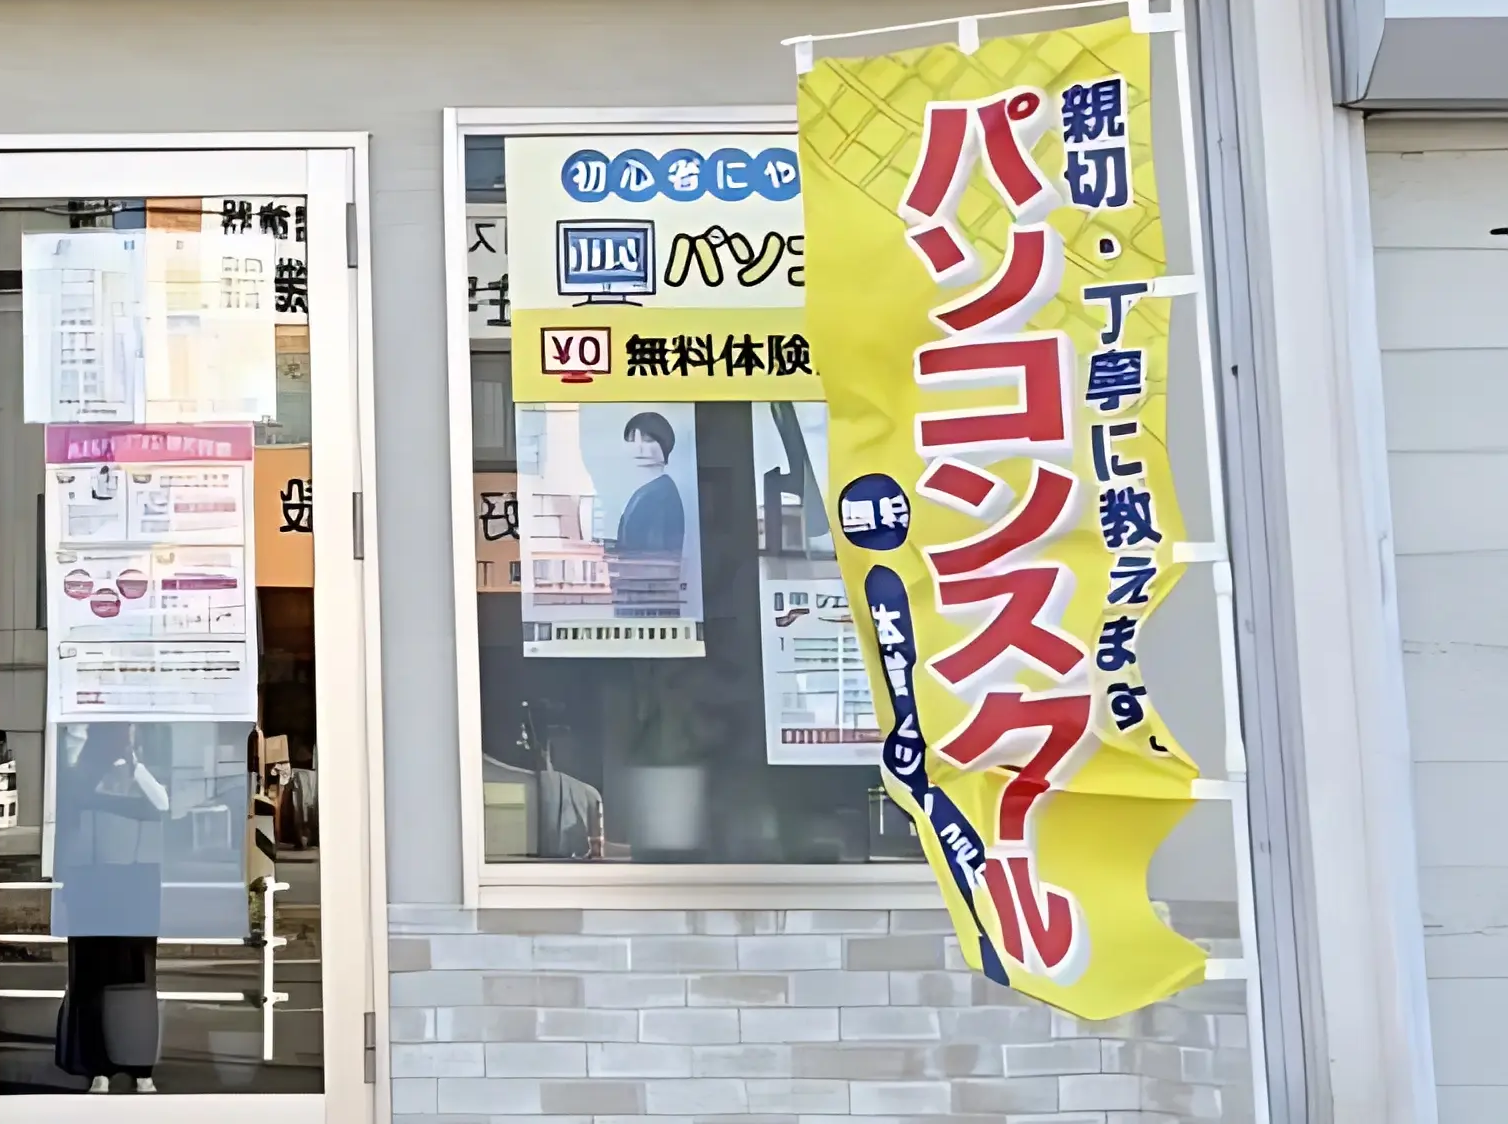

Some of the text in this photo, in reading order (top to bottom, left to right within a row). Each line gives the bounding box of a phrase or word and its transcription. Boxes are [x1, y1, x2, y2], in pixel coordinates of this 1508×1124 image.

[902, 86, 1092, 972] パソコンスクール
